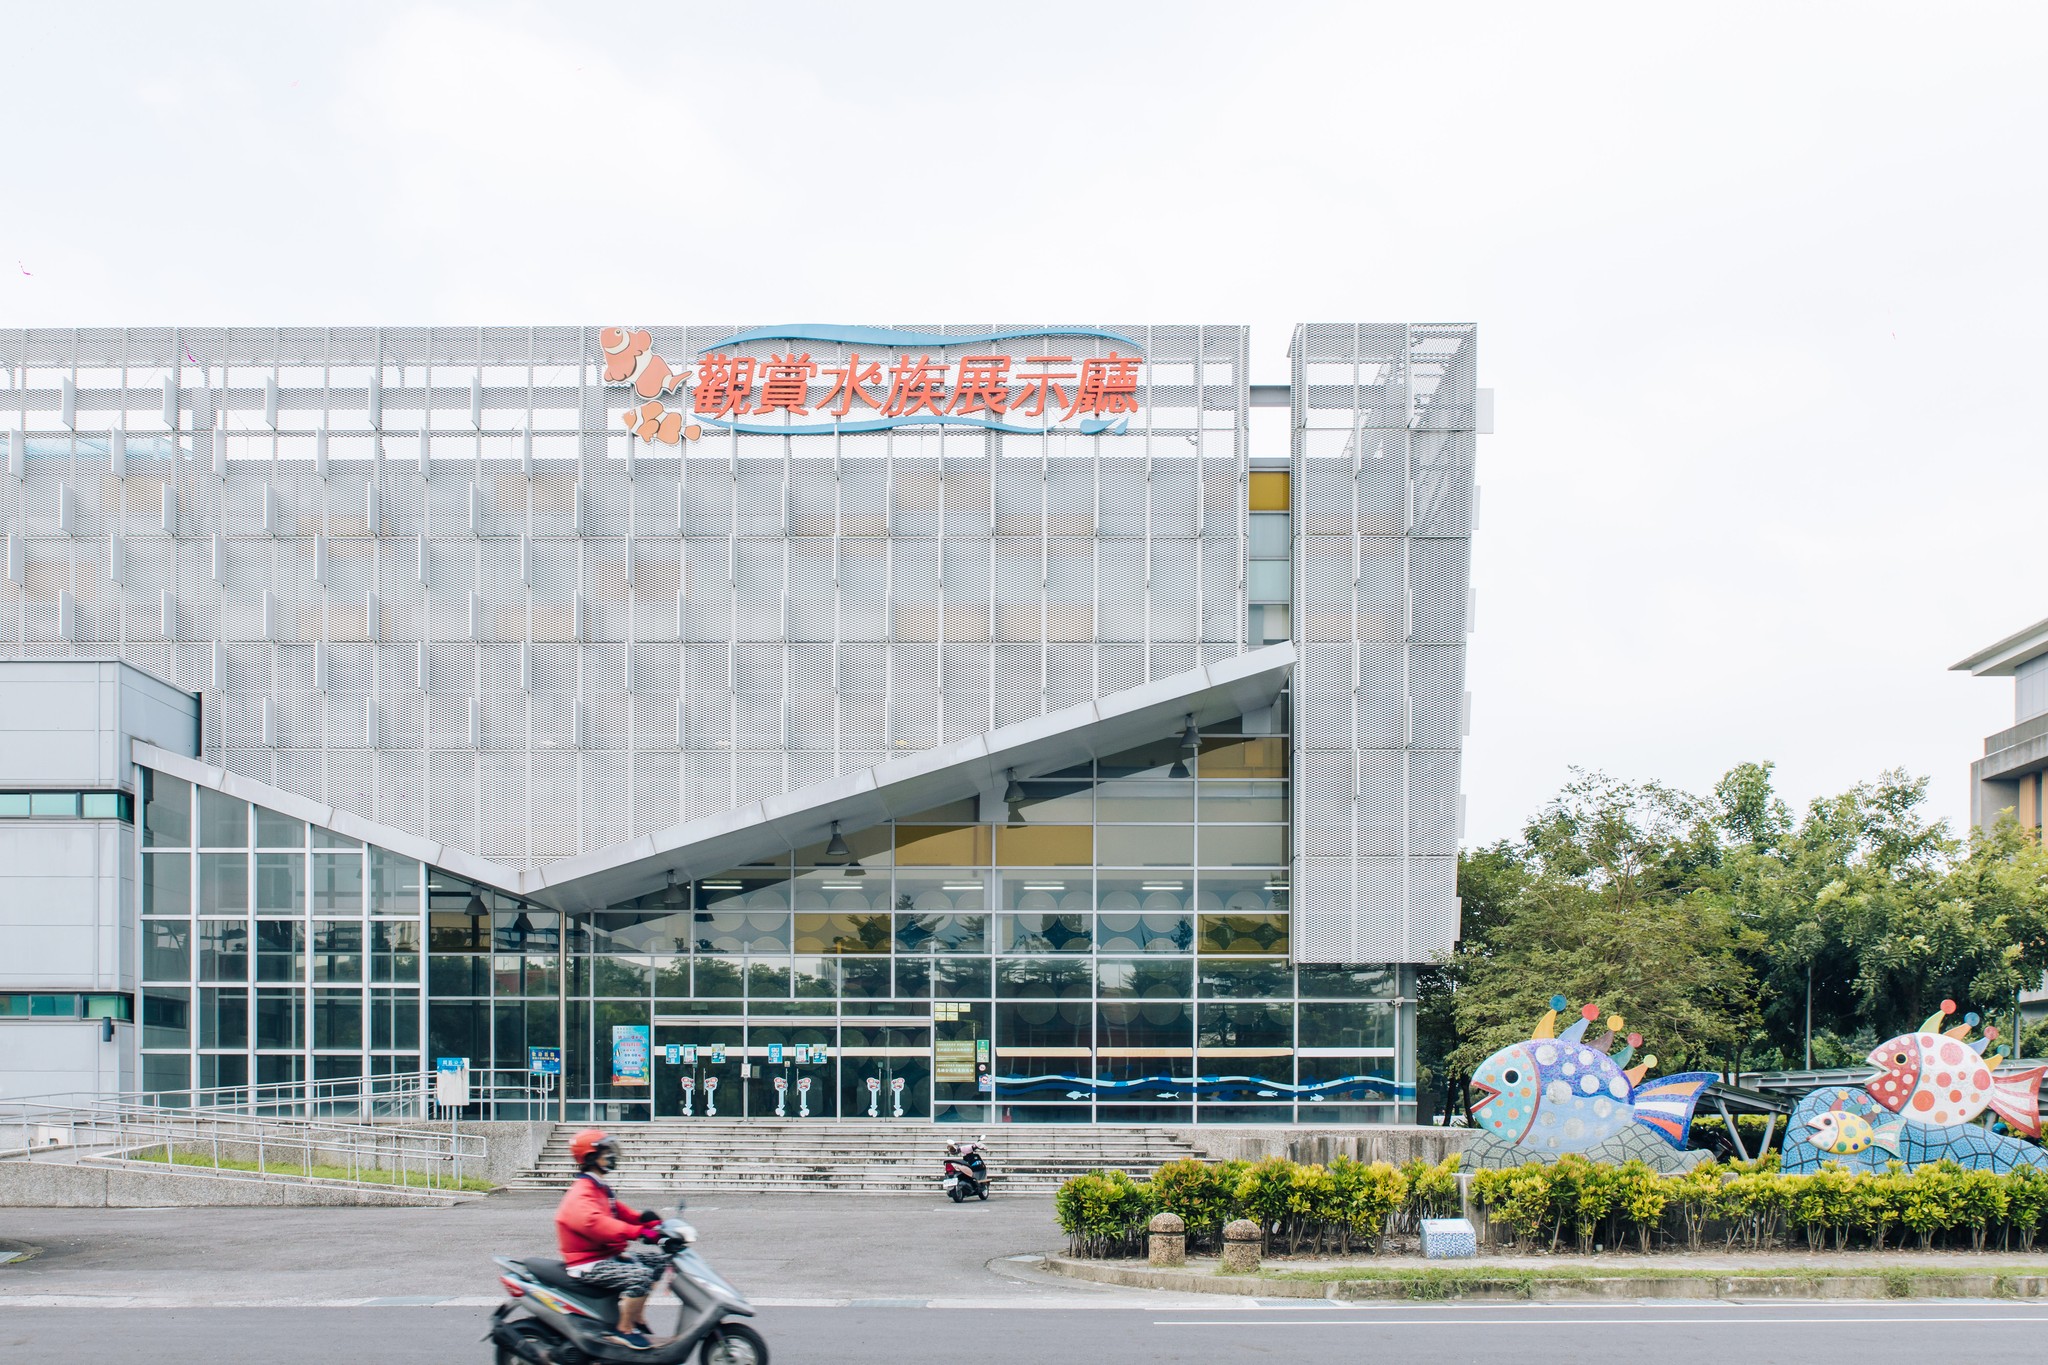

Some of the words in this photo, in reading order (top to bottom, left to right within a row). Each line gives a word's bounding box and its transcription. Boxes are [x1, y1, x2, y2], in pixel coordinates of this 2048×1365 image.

[692, 351, 1143, 422] 觀賞水族展示廳
